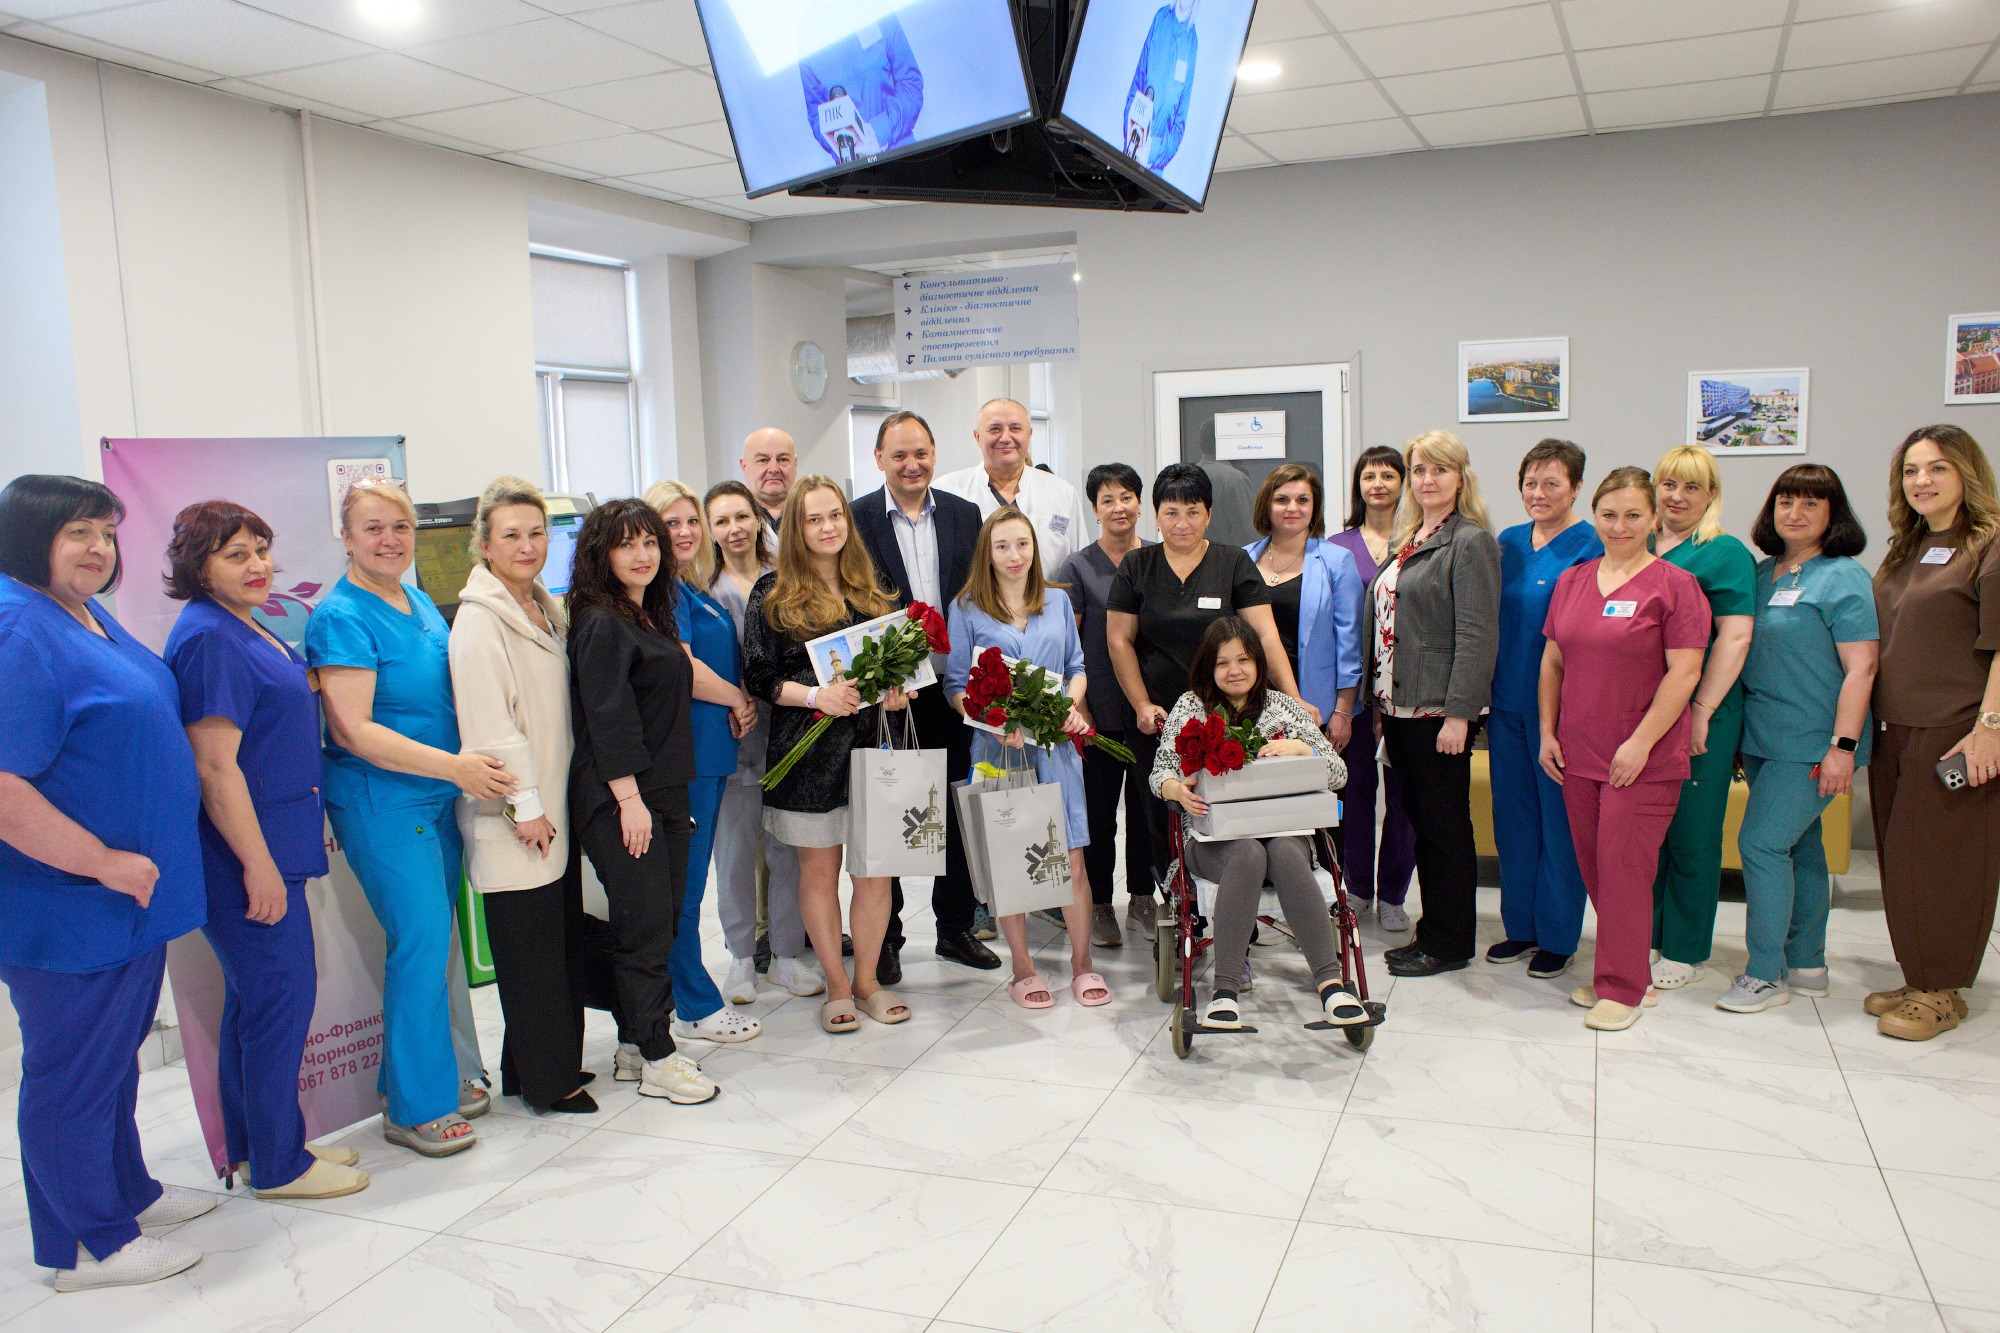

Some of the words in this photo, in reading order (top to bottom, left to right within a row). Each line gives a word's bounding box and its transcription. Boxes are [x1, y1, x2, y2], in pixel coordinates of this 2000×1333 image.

[824, 105, 843, 123] ПІК
[920, 276, 1004, 289] Консультативно
[919, 289, 985, 302] діагностичне
[986, 285, 1040, 297] відділення
[920, 304, 957, 314] Клініко
[964, 298, 1032, 311] діагностичне
[920, 316, 970, 327] відділення
[921, 326, 1003, 339] Катамнестичне
[921, 339, 999, 351] спостереження
[922, 354, 962, 364] Палати
[964, 350, 1011, 362] сумісного
[1013, 346, 1075, 359] перебування
[298, 1071, 325, 1092] 067
[330, 1060, 358, 1080] 878
[361, 1052, 380, 1070] 22
